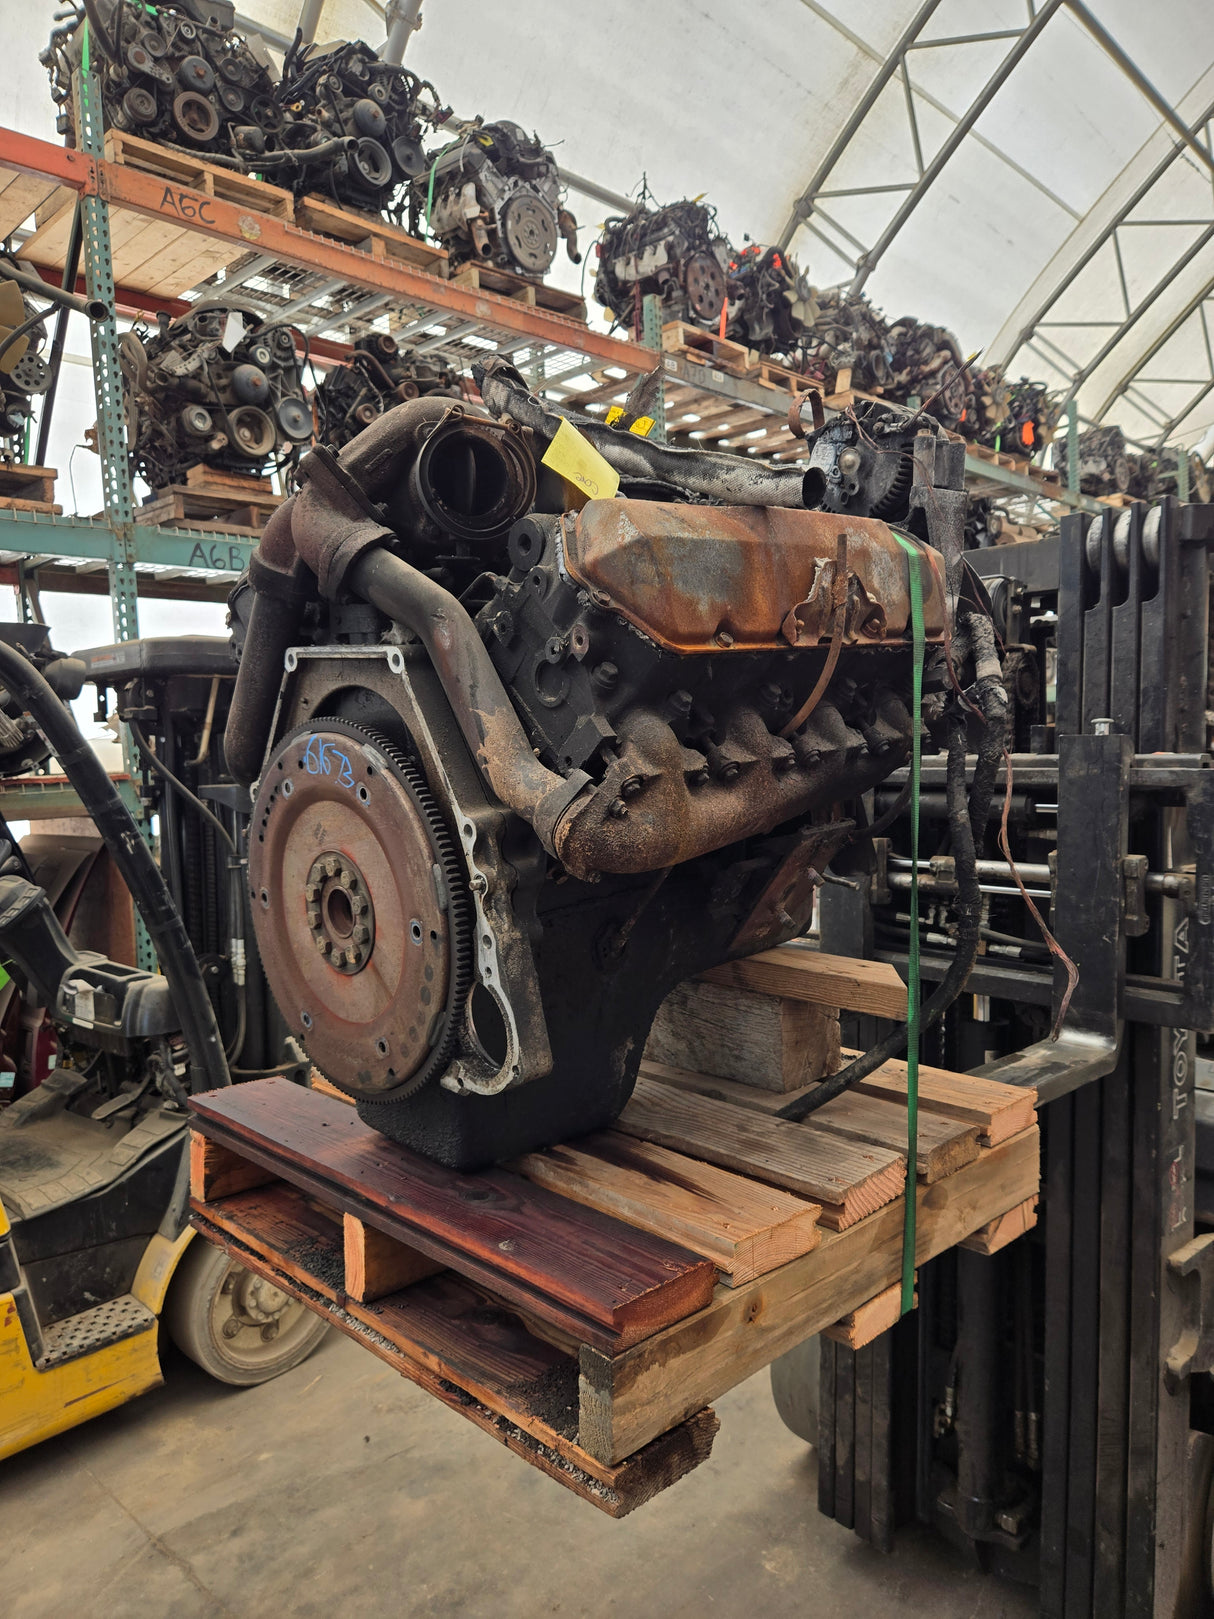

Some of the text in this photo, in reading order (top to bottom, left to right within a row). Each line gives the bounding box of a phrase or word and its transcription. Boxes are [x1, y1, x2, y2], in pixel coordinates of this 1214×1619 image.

[160, 186, 216, 224] A6C
[188, 542, 245, 571] A6B
[1173, 917, 1189, 1119] TOYTA
